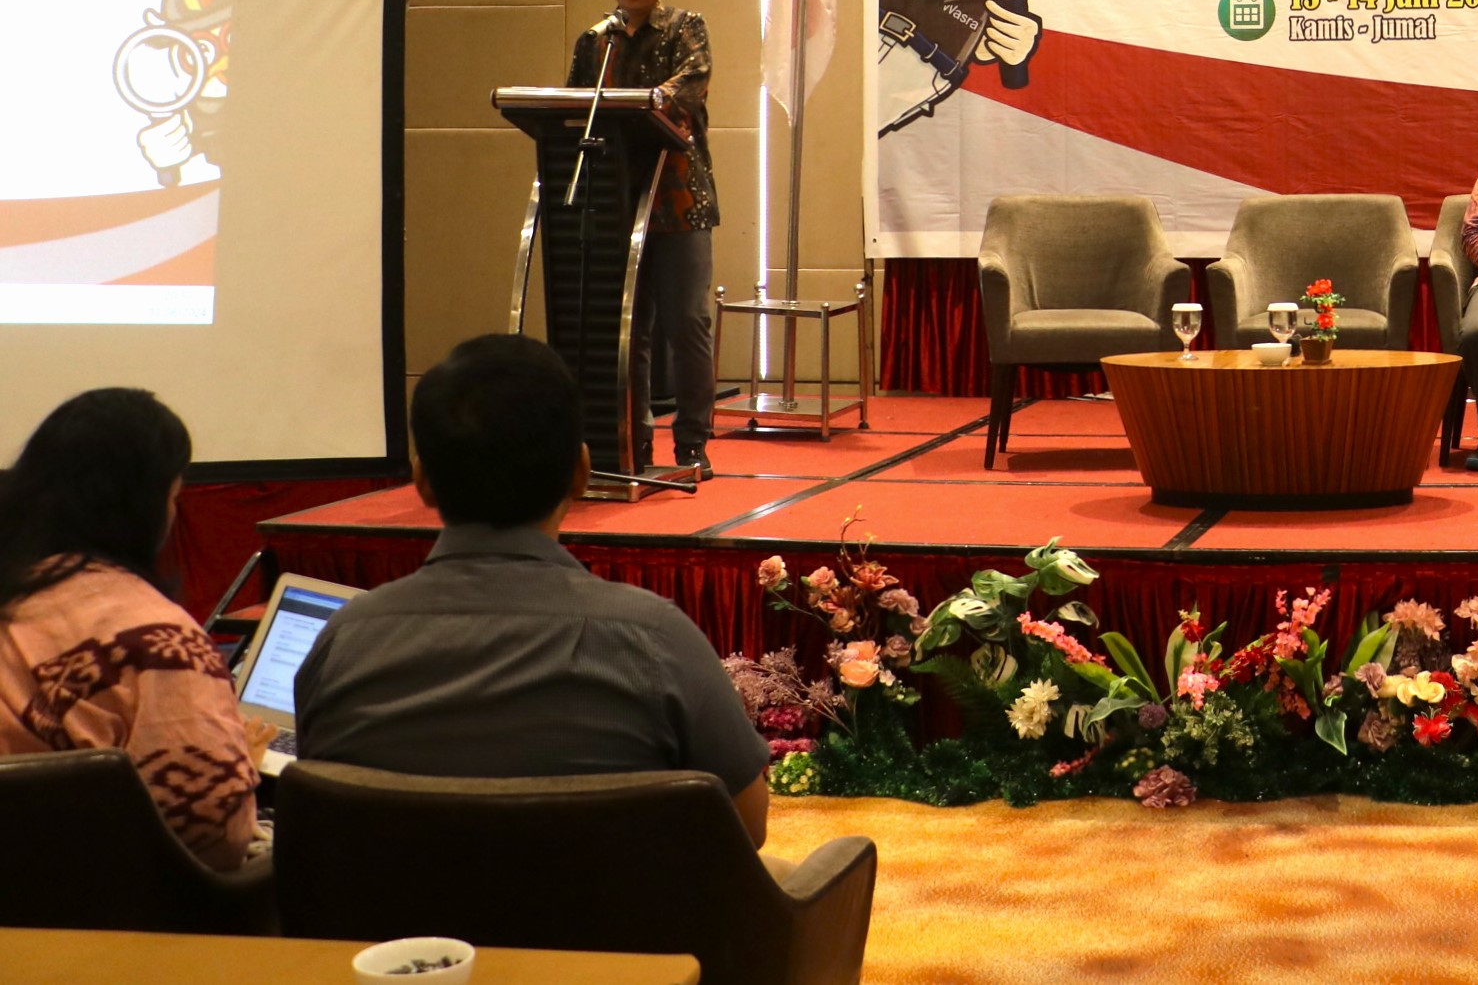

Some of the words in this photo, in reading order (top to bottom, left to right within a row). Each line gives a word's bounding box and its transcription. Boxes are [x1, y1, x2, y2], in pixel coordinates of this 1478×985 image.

[943, 4, 979, 30] Wasra
[1289, 16, 1354, 41] Kamis
[1371, 14, 1436, 43] Jumat
